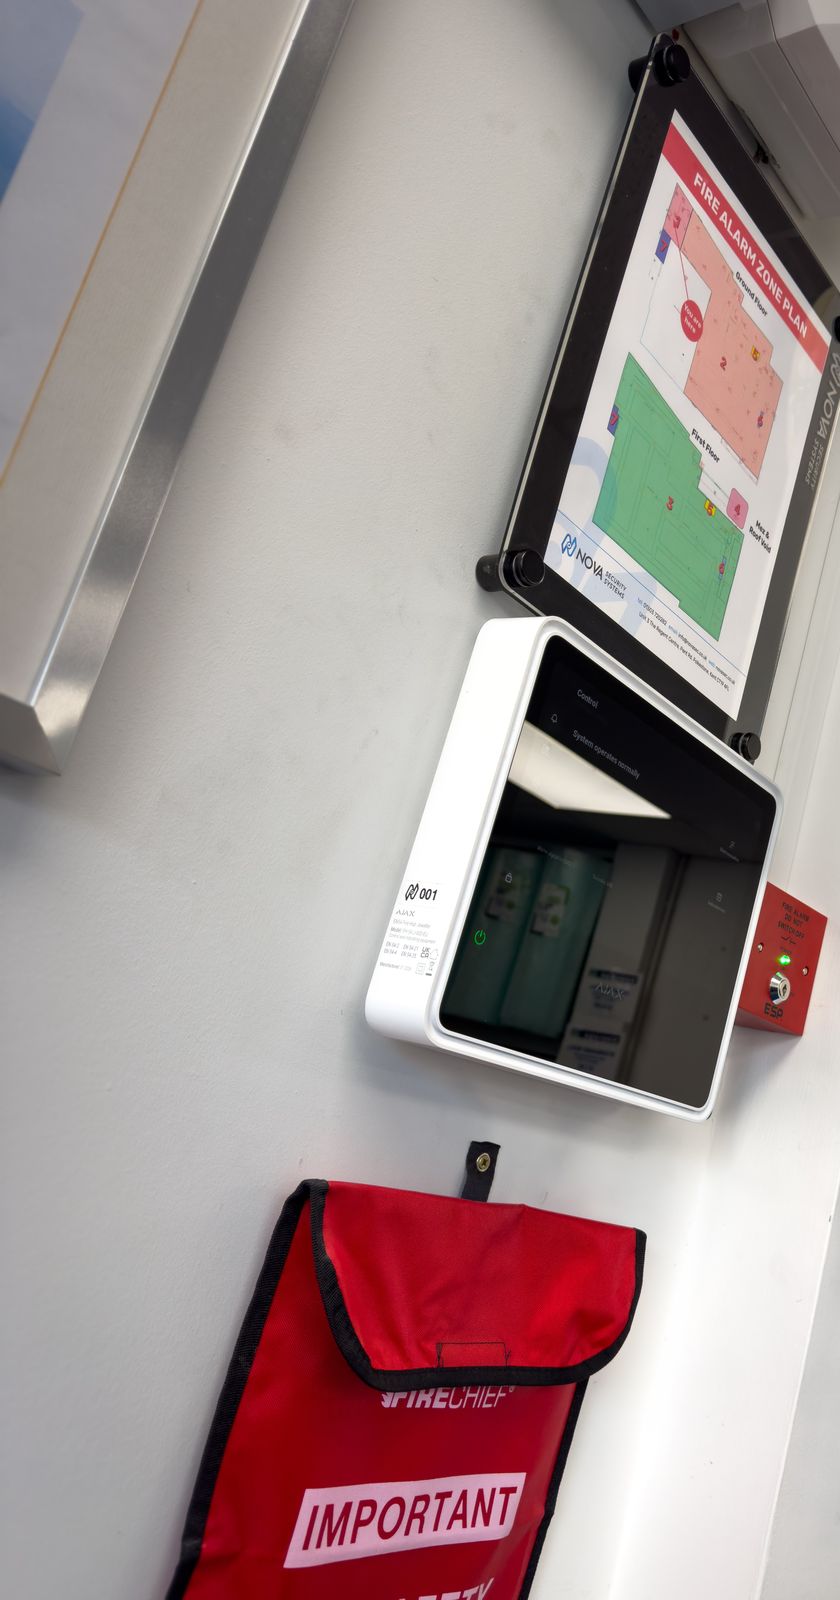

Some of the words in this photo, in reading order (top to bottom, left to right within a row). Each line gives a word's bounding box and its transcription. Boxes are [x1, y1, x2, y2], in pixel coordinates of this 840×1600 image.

[693, 172, 721, 215] FIRE
[719, 211, 757, 266] ALARM
[755, 258, 783, 304] ZONE
[782, 298, 808, 339] PLAN
[735, 271, 756, 301] Ground
[754, 295, 768, 317] Floor
[683, 303, 694, 320] You
[692, 316, 702, 328] are
[684, 318, 697, 334] here
[720, 356, 727, 371] 2
[817, 381, 835, 440] NOVA
[691, 428, 706, 448] First
[705, 443, 720, 463] Floor
[804, 437, 818, 485] SYSTEMS
[749, 526, 761, 543] Roof
[760, 538, 772, 554] Void
[576, 548, 603, 580] NOVA
[604, 571, 627, 591] SECURITY
[603, 578, 625, 599] SYSTEMS
[577, 689, 599, 709] Control
[573, 730, 594, 749] System
[594, 745, 618, 765] operates
[617, 760, 640, 780] normally
[420, 888, 438, 901] 001
[395, 909, 415, 917] AJAX
[763, 1002, 784, 1019] ESP
[302, 1486, 518, 1550] IMPORTANT
